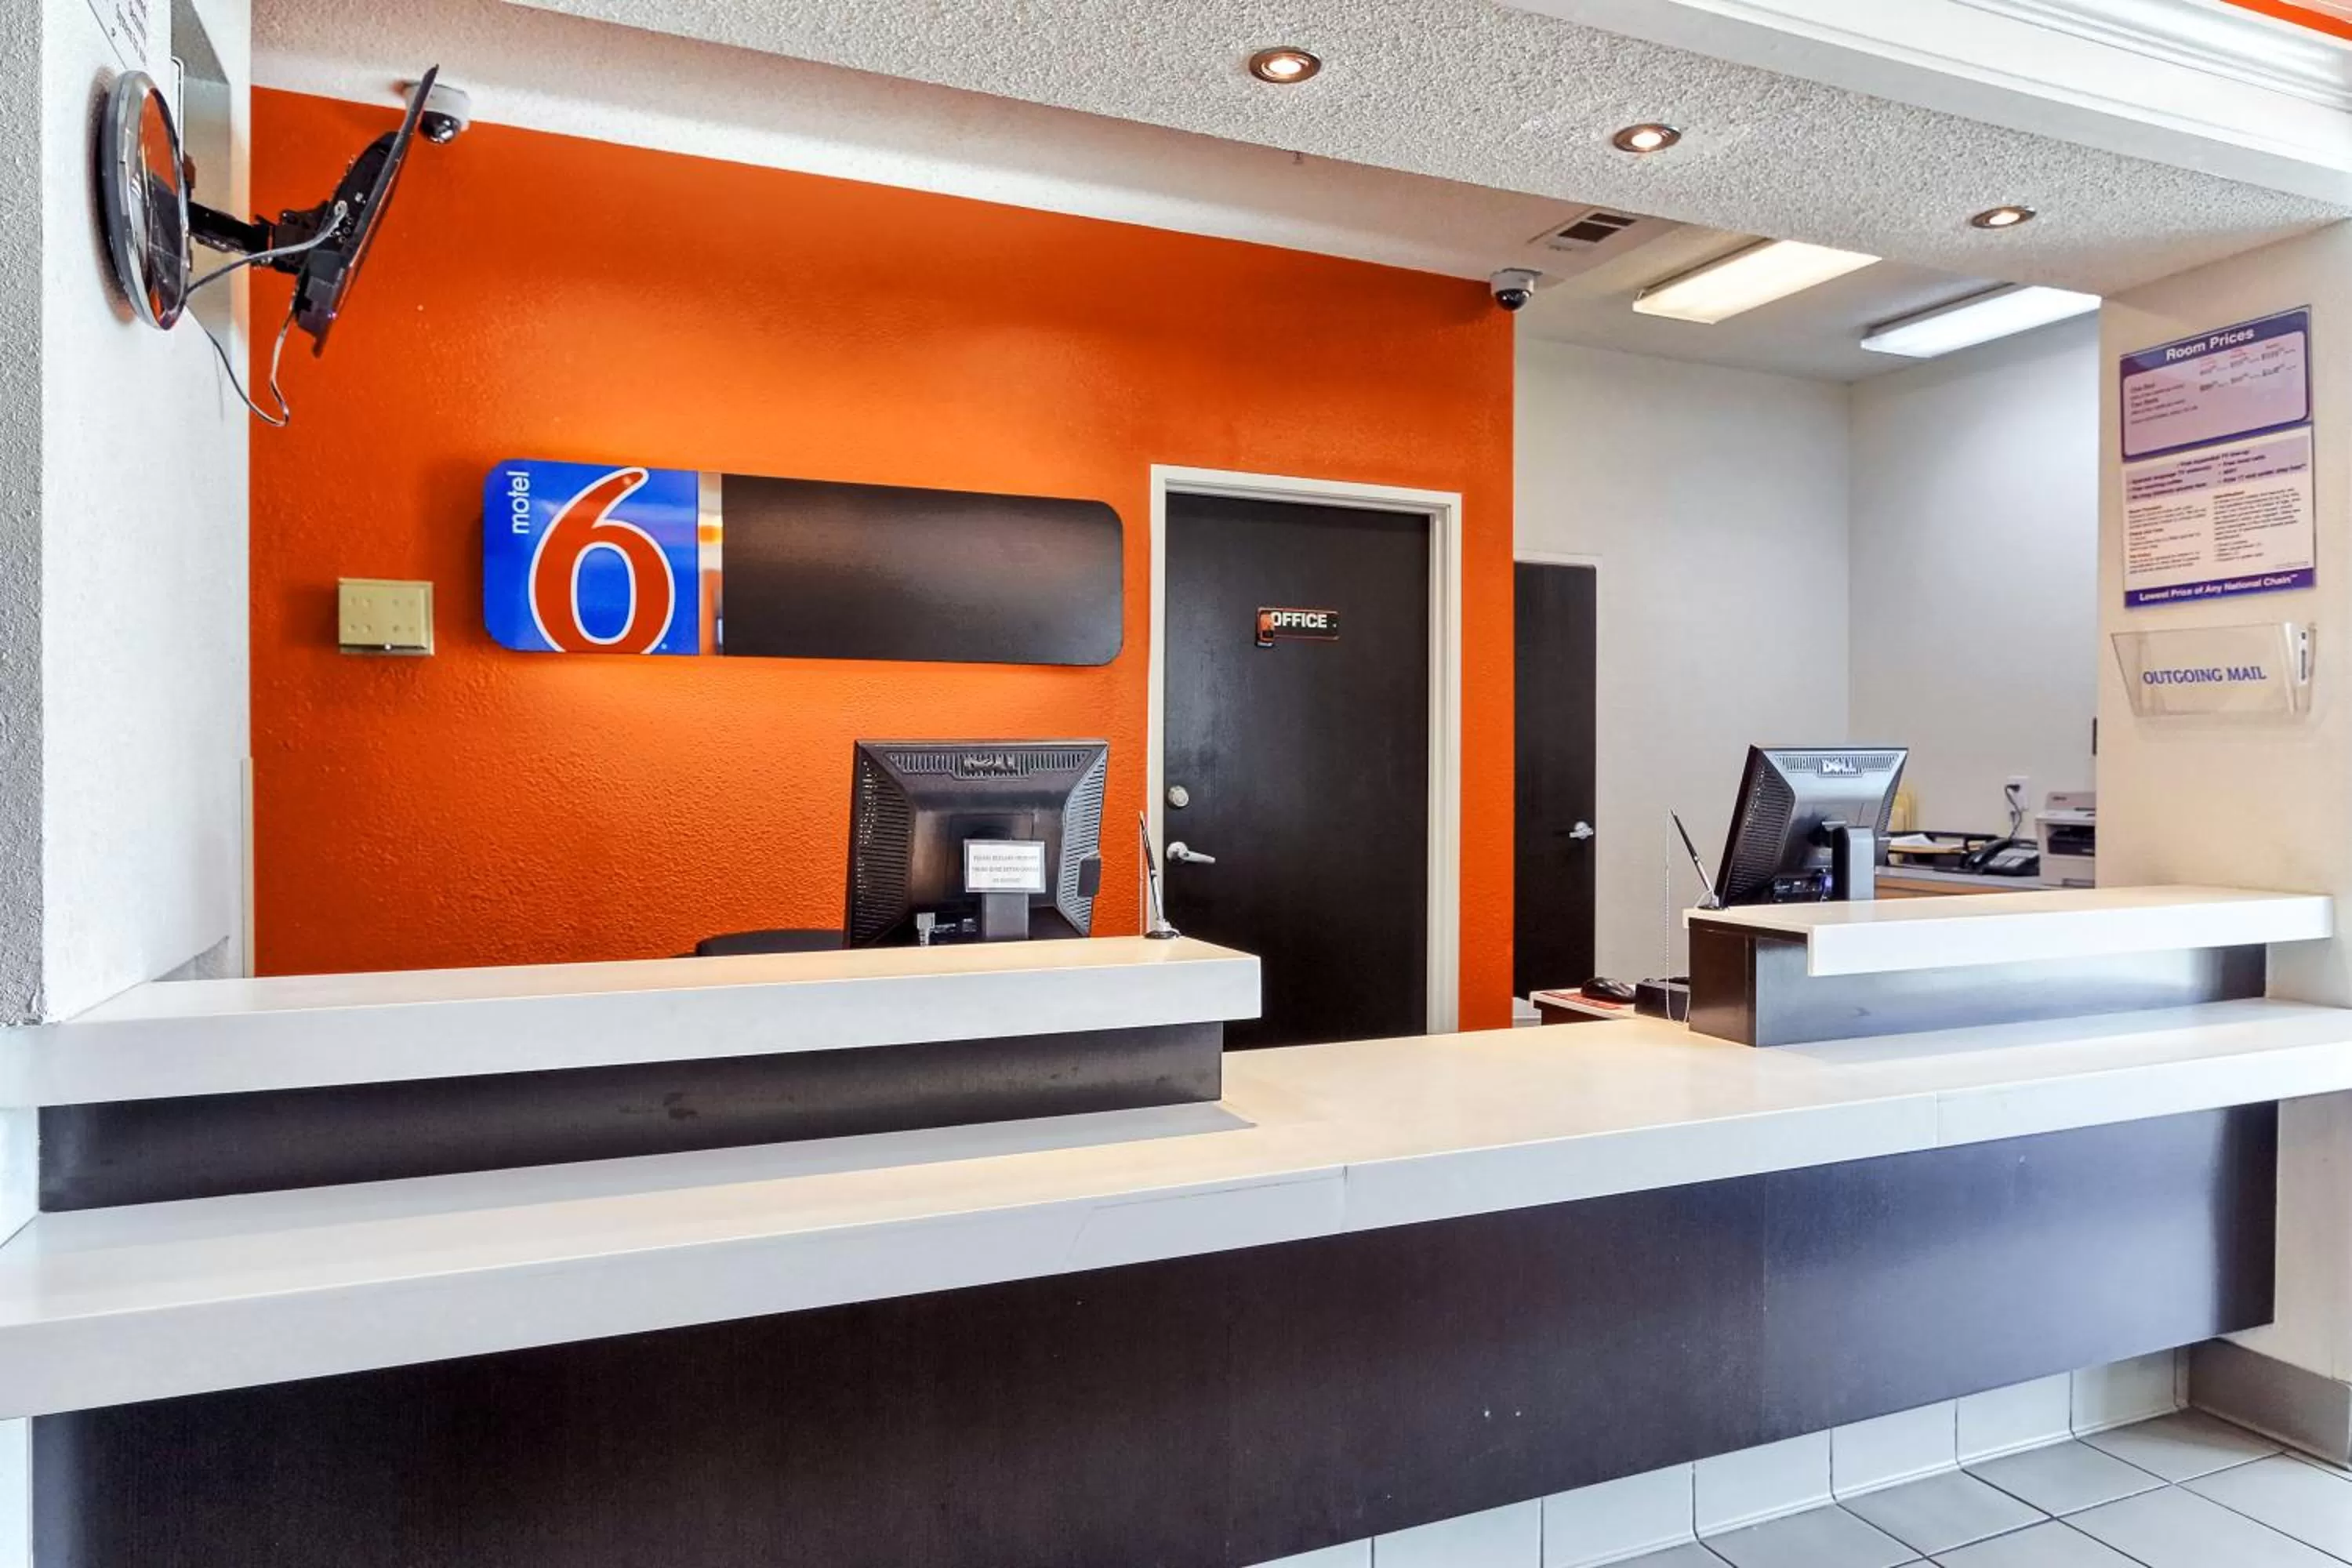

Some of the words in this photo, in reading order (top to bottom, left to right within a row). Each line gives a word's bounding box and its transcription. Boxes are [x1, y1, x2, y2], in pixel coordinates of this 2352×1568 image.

[2166, 342, 2205, 361] Room
[2209, 328, 2255, 349] Prices
[506, 470, 530, 534] motel
[528, 466, 676, 654] 6
[1271, 611, 1327, 628] OFFICE
[2143, 668, 2223, 684] OUTGOING
[2226, 666, 2267, 681] MAIL
